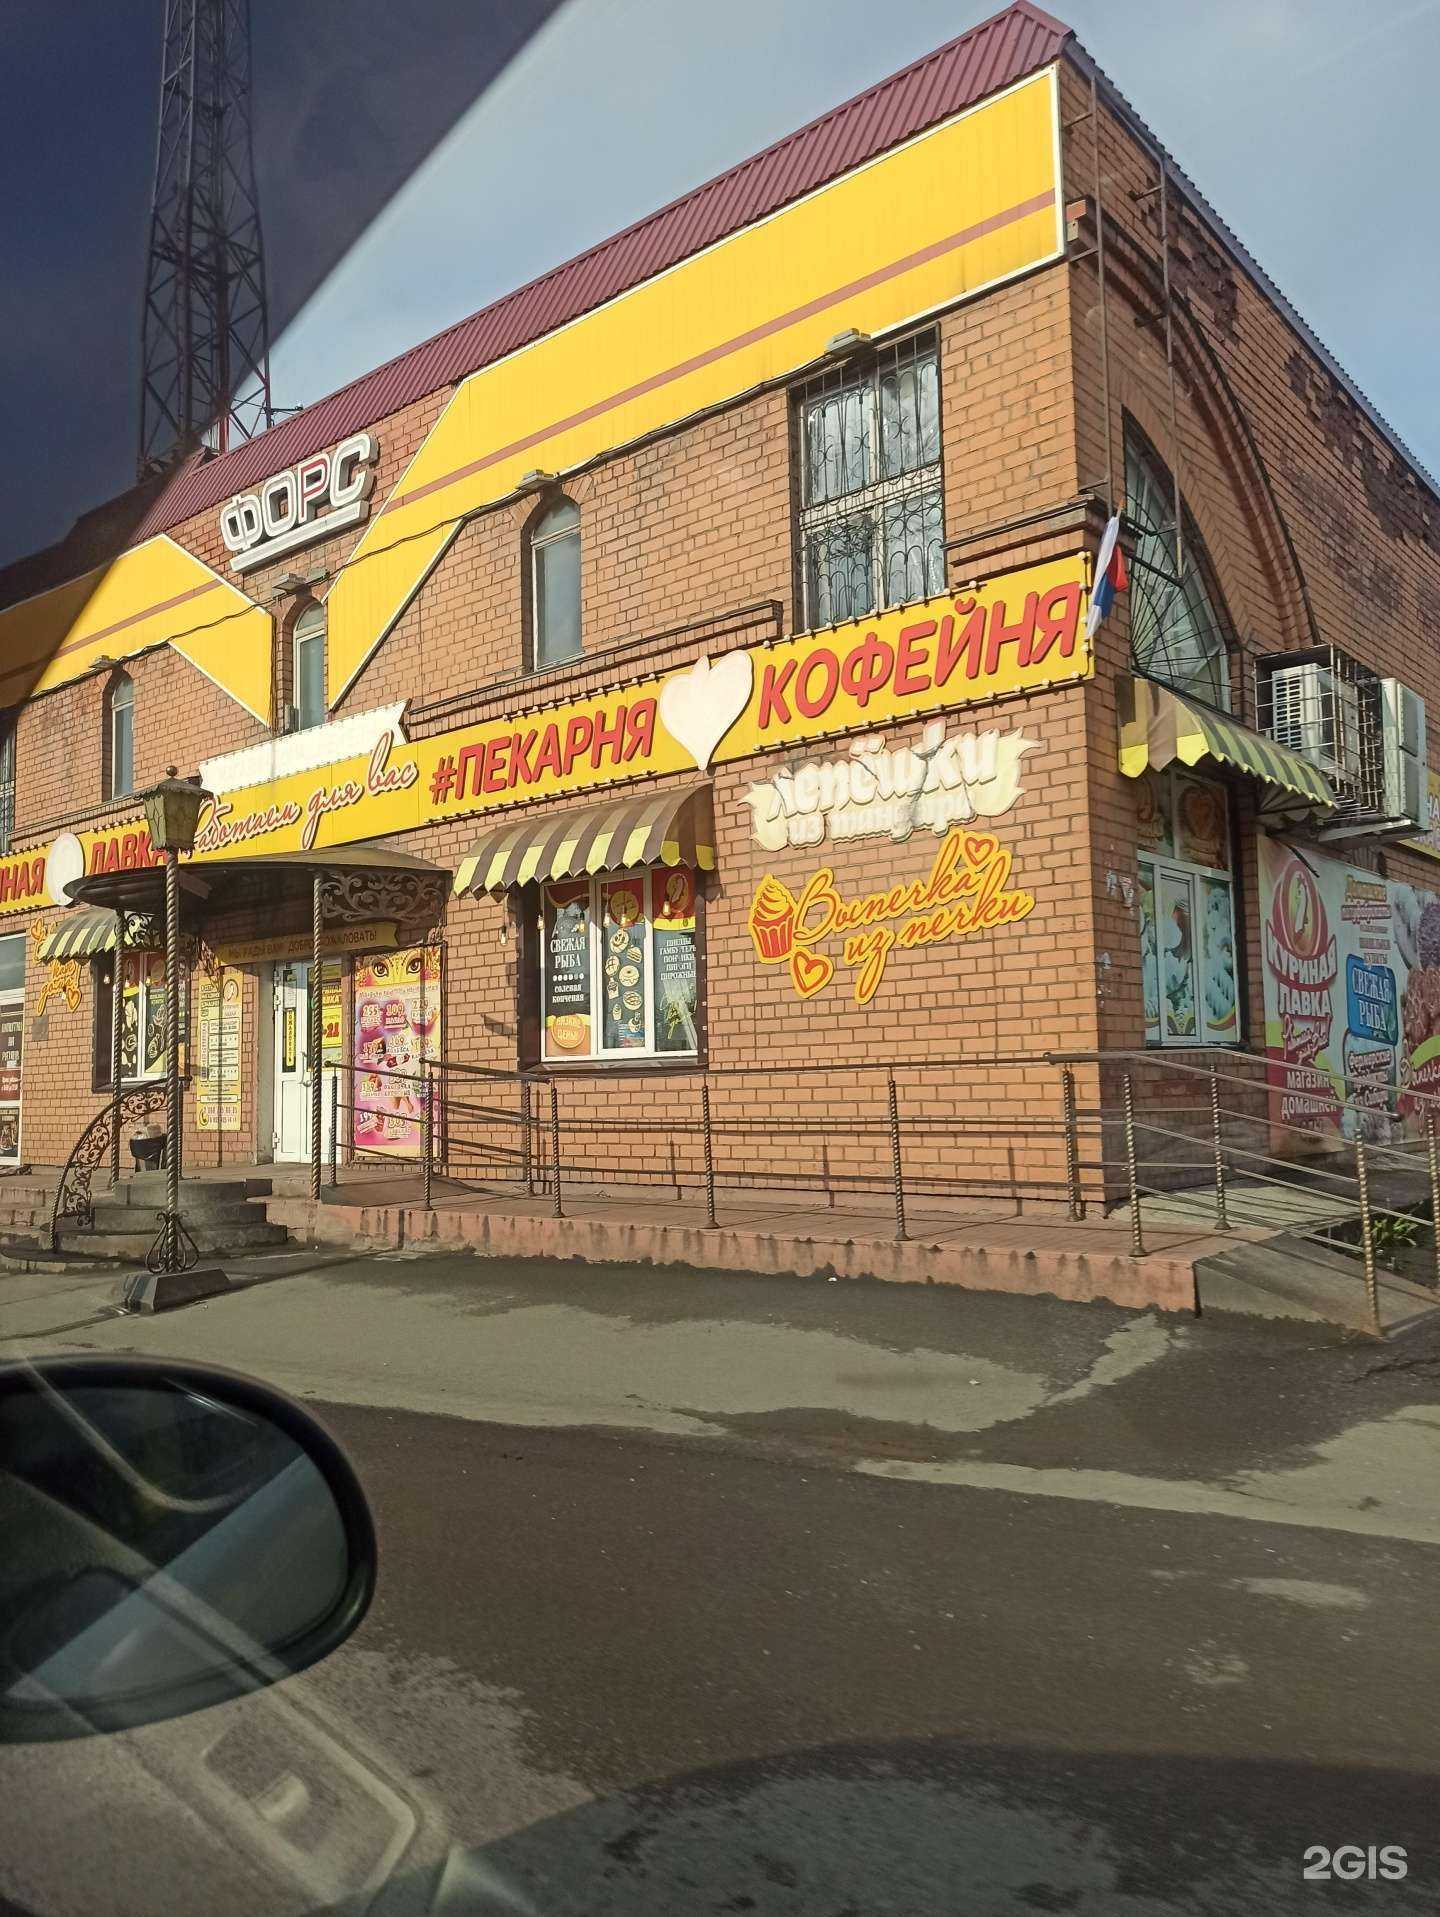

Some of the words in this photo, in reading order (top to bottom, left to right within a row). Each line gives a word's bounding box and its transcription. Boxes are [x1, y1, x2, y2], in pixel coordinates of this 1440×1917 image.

[220, 433, 372, 551] ФОРС
[429, 698, 657, 804] #ПЕКАРНЯ
[758, 582, 1083, 729] КОФЕЙНЯ
[301, 781, 364, 850] для
[368, 730, 418, 796] вас
[793, 833, 980, 941] Выпечка
[550, 936, 586, 954] СВЕЖАЯ
[847, 930, 891, 999] из
[901, 855, 1030, 944] печки
[554, 954, 582, 969] РЫБА
[1267, 925, 1335, 984] КУРИНАЯ
[1279, 982, 1331, 1016] ЛАВКА
[1352, 967, 1391, 1003] СВЕЖАЯ
[1358, 1000, 1388, 1032] РЫБА
[1286, 1071, 1330, 1089] магазин
